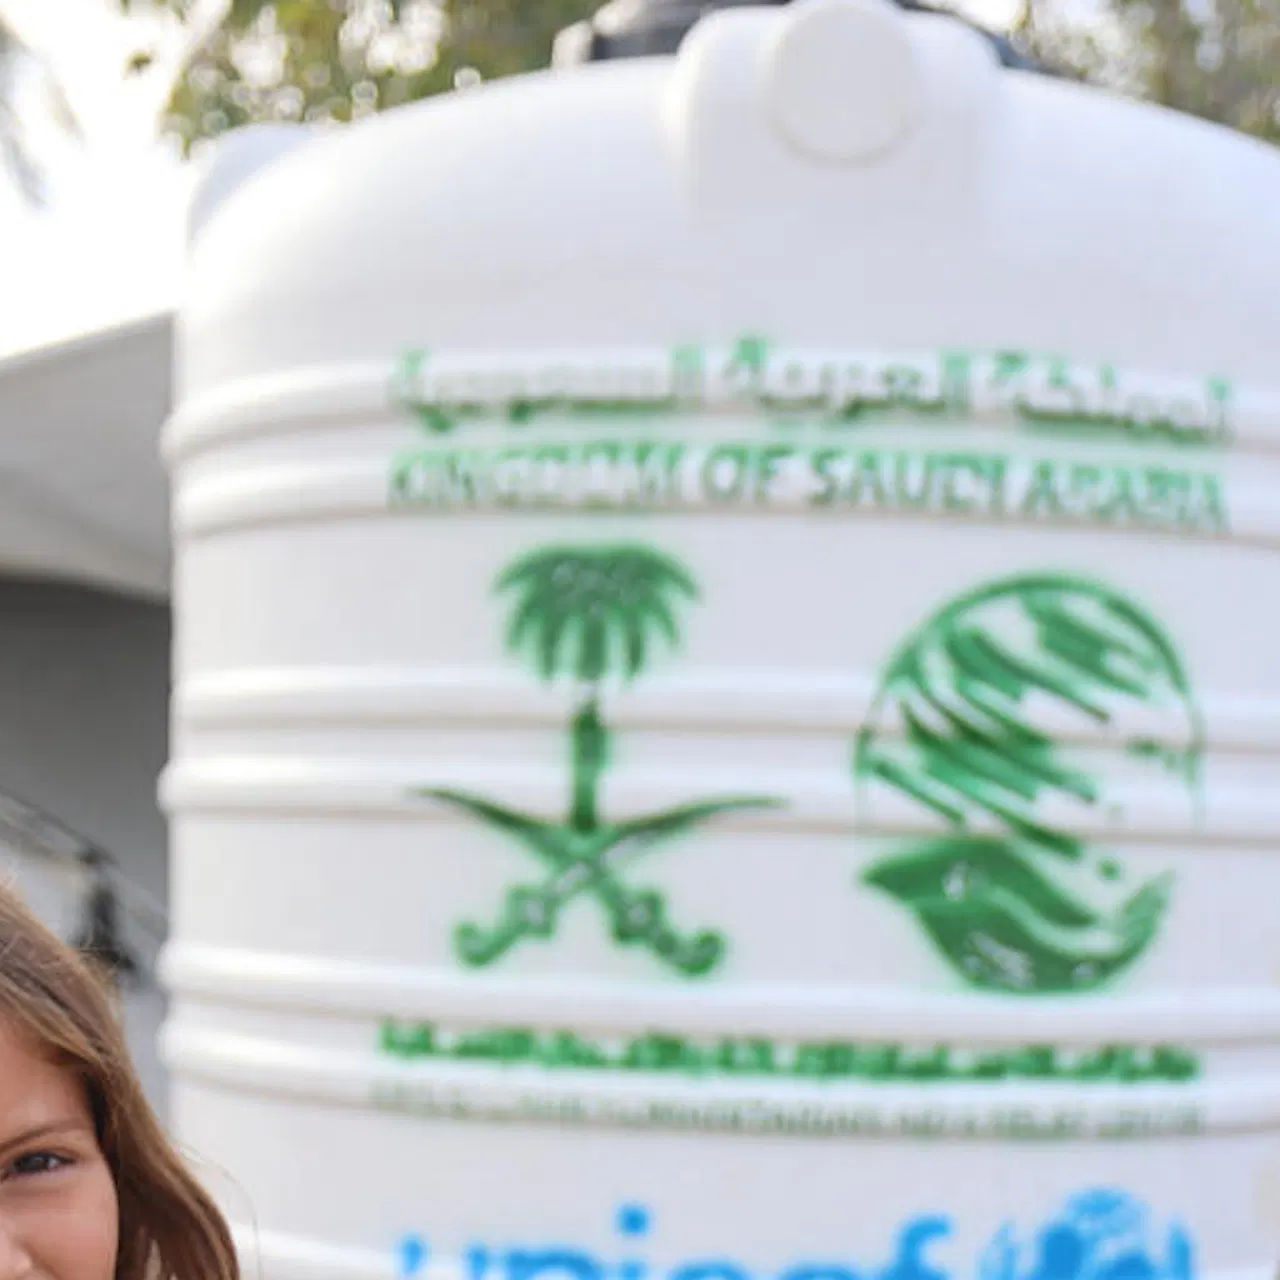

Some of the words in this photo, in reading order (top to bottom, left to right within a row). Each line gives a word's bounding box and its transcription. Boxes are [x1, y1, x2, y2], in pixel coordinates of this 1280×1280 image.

[388, 440, 688, 508] KINGDOM
[702, 442, 796, 508] OF
[808, 448, 1010, 516] SAUDI
[1024, 458, 1230, 536] ARABIA
